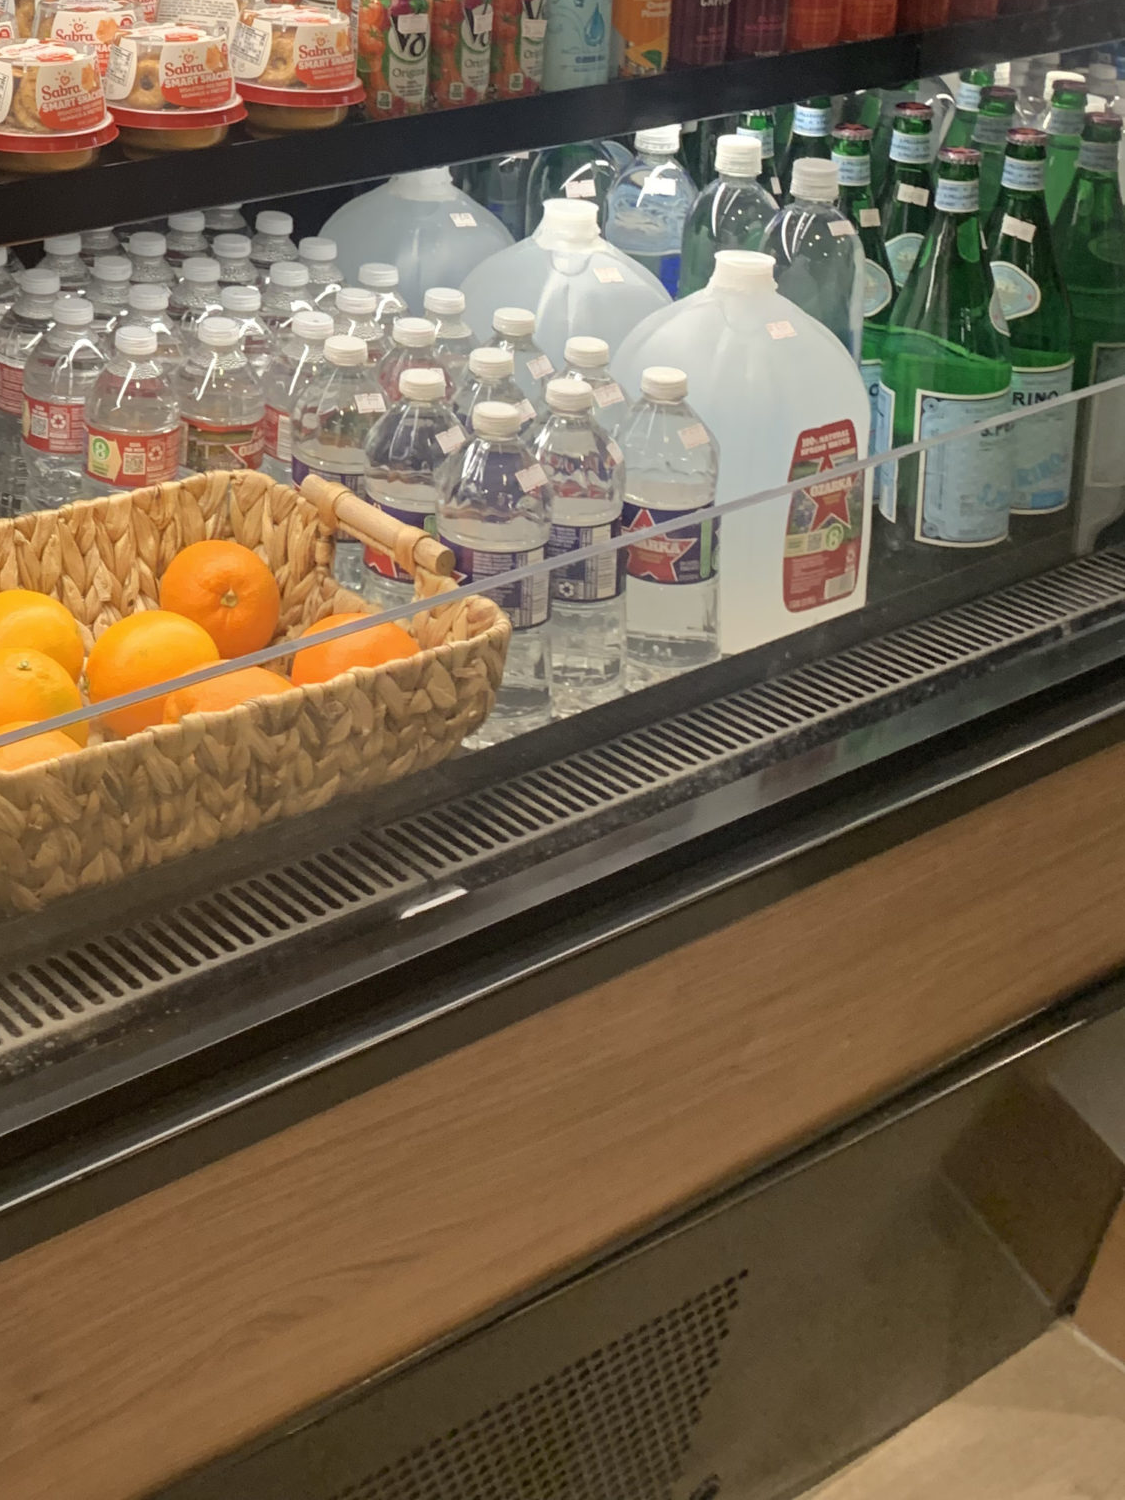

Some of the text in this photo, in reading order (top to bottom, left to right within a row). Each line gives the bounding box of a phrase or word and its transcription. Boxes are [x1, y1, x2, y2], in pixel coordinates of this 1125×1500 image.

[299, 45, 335, 59] Sabra
[165, 62, 204, 77] Sabra
[299, 59, 330, 70] SMART
[164, 75, 199, 89] SMART
[42, 85, 81, 101] Sabra
[42, 96, 78, 113] SMART
[819, 429, 850, 442] NATURAL
[801, 436, 851, 456] SPRING WATER
[810, 476, 853, 497] OZARKA
